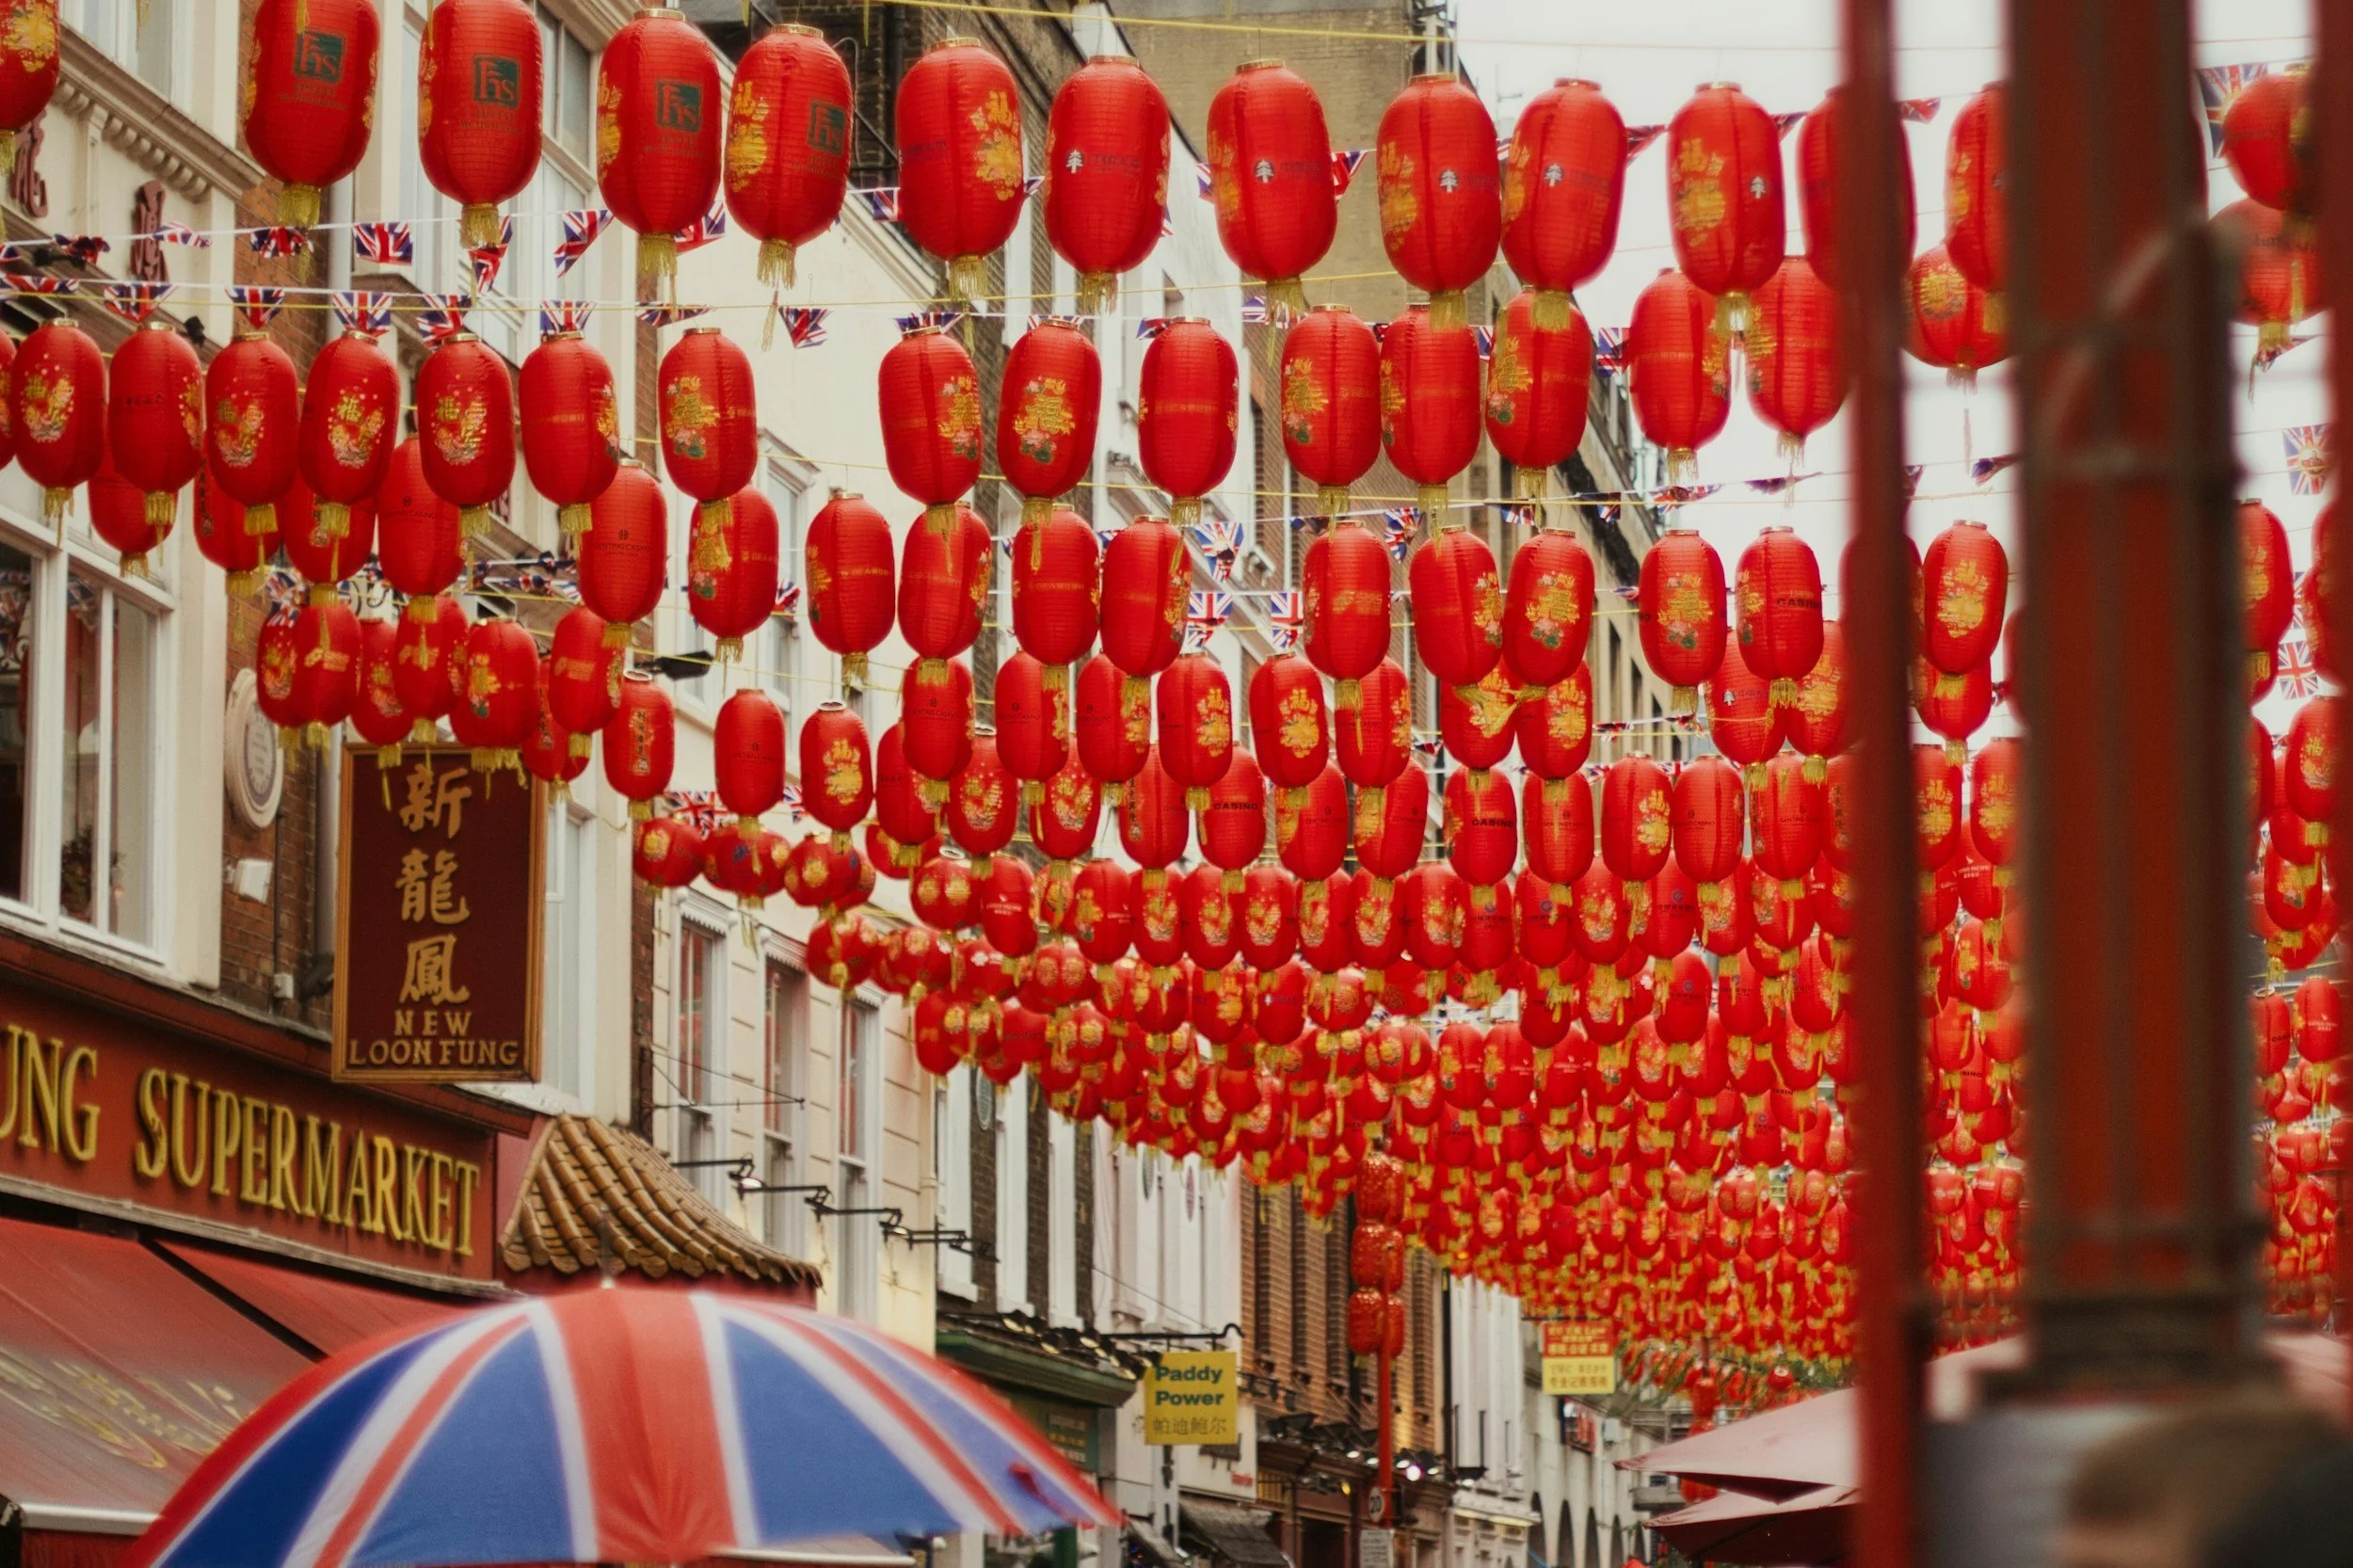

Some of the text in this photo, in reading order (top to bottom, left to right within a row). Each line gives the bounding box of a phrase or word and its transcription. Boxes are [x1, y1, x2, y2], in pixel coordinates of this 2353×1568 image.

[1213, 802, 1258, 810] CASINO
[1471, 818, 1514, 827] CASINO
[395, 763, 472, 1006] 新龍鳳
[394, 1010, 472, 1036] NEW
[349, 1039, 518, 1065] LOON FUNG
[136, 1067, 481, 1256] SUPERMARKET
[1155, 1366, 1223, 1384] Paddy
[1155, 1391, 1225, 1406] Power
[1370, 1495, 1384, 1514] 20
